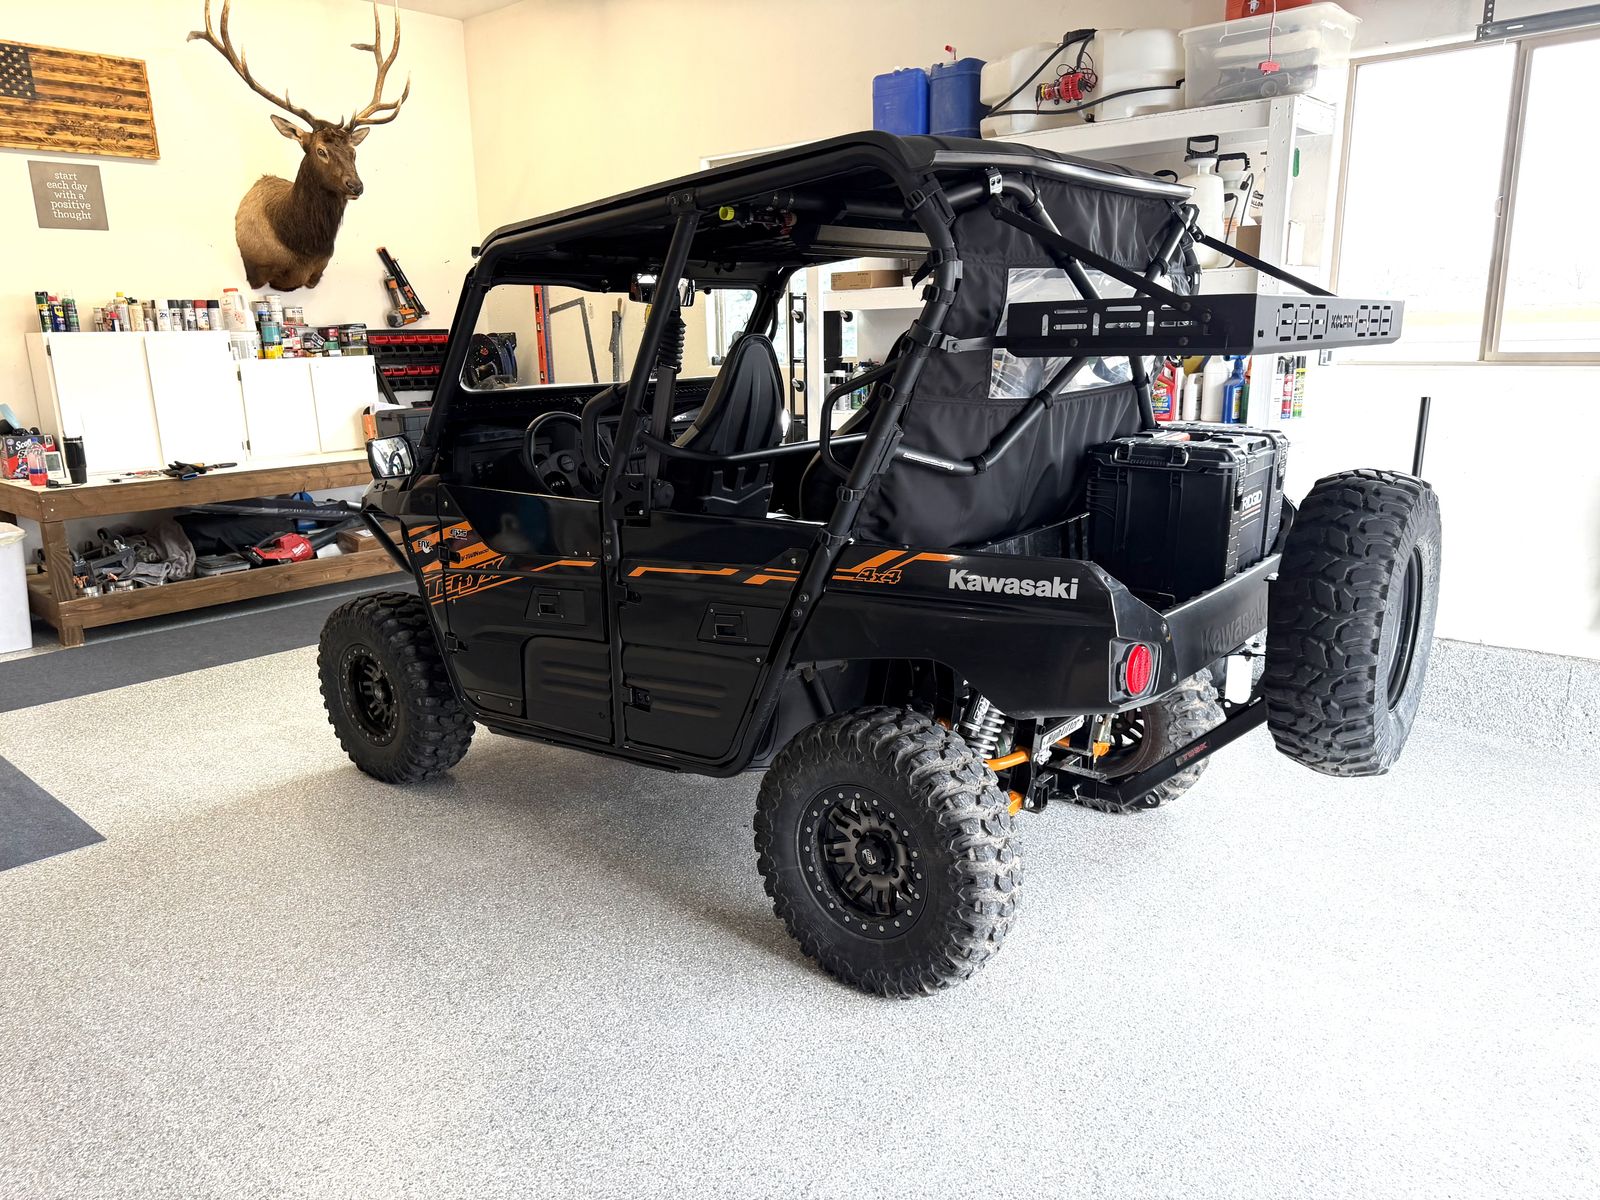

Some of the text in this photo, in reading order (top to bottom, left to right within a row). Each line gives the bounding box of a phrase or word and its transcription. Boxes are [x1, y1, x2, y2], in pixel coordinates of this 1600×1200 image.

[54, 172, 77, 180] start
[46, 181, 88, 192] each day
[53, 190, 77, 200] with
[50, 200, 91, 210] positive
[53, 210, 92, 221] thought
[856, 566, 902, 584] 4x4
[949, 568, 1079, 600] Kawasaki
[1200, 597, 1267, 660] Kawasak
